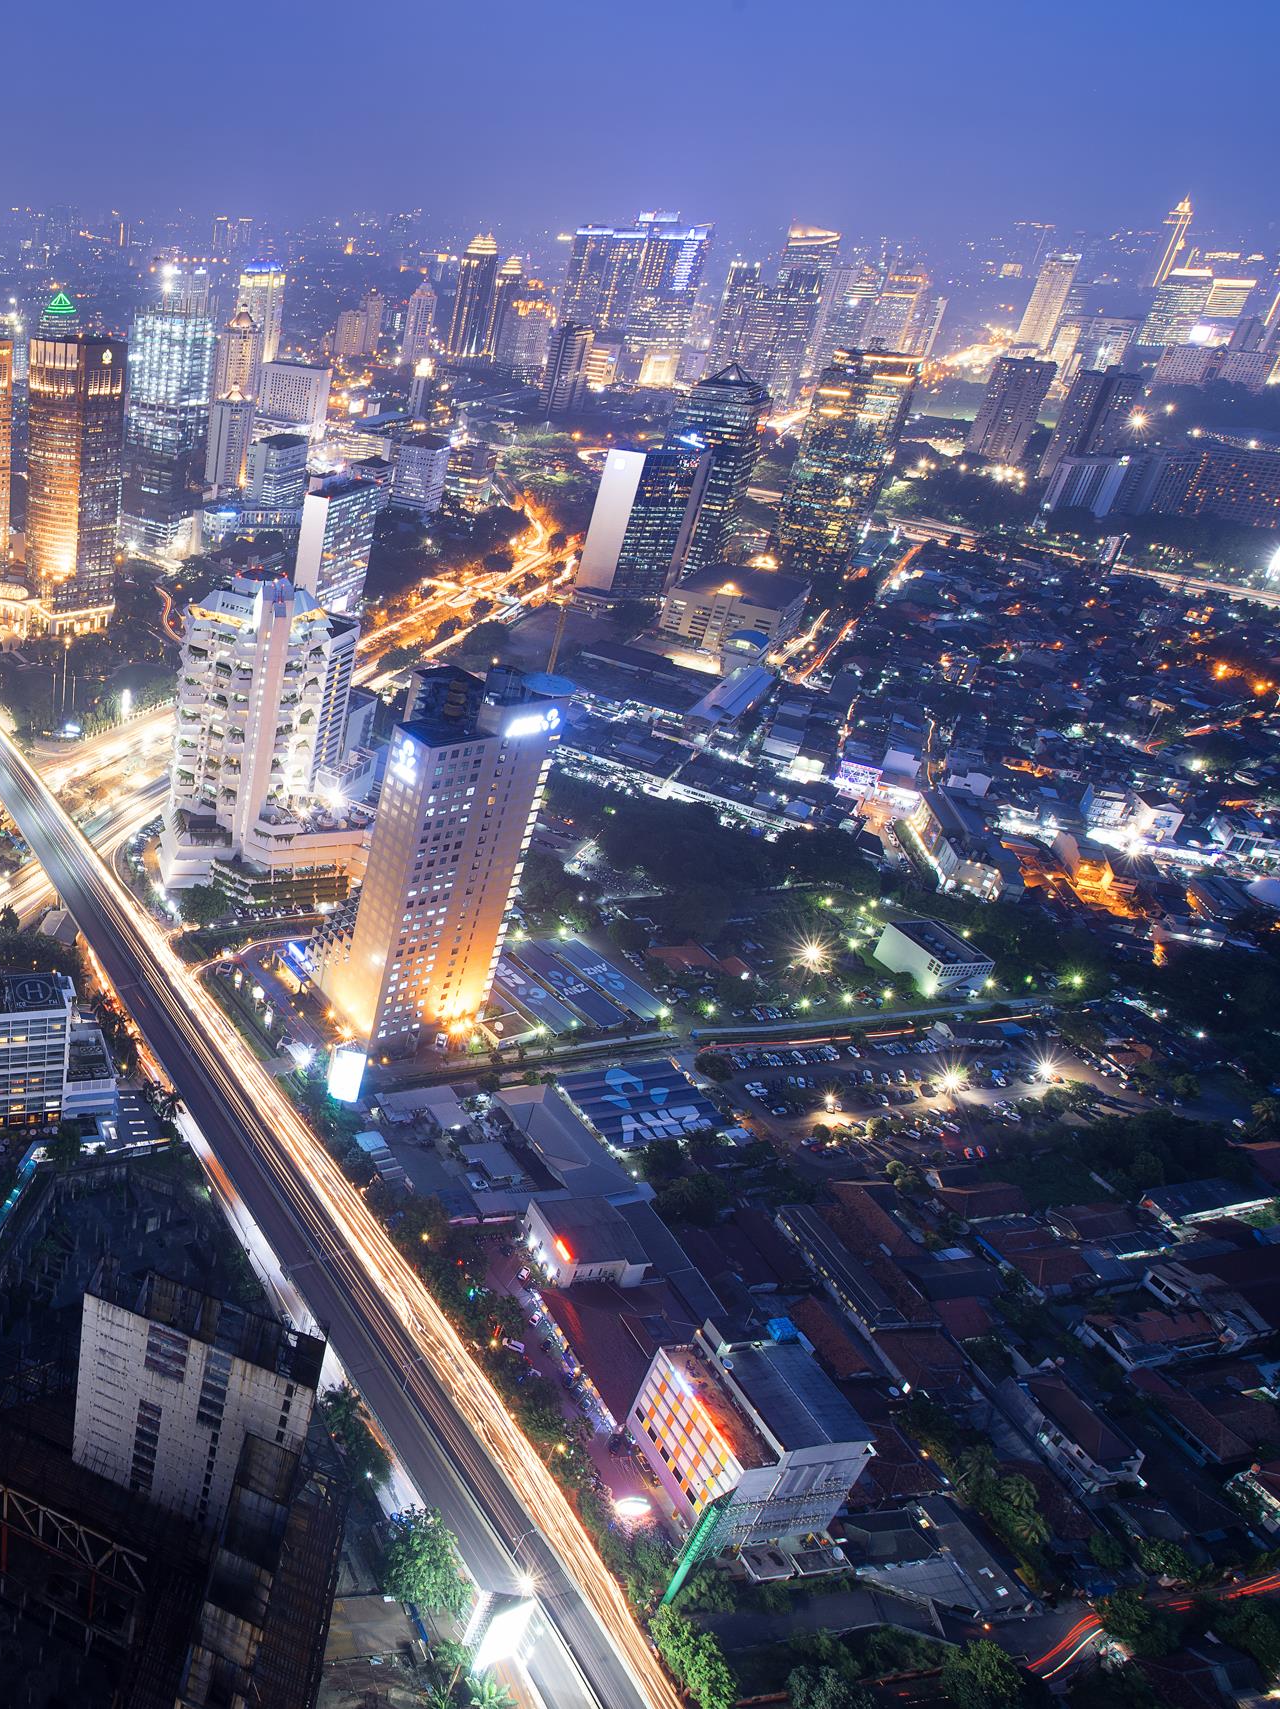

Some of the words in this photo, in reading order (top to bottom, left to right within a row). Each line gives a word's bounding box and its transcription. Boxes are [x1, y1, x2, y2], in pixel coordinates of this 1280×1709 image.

[583, 963, 607, 975] ANZ
[24, 983, 44, 1000] H
[563, 983, 590, 996] ANZ
[621, 1105, 713, 1144] ANZ
